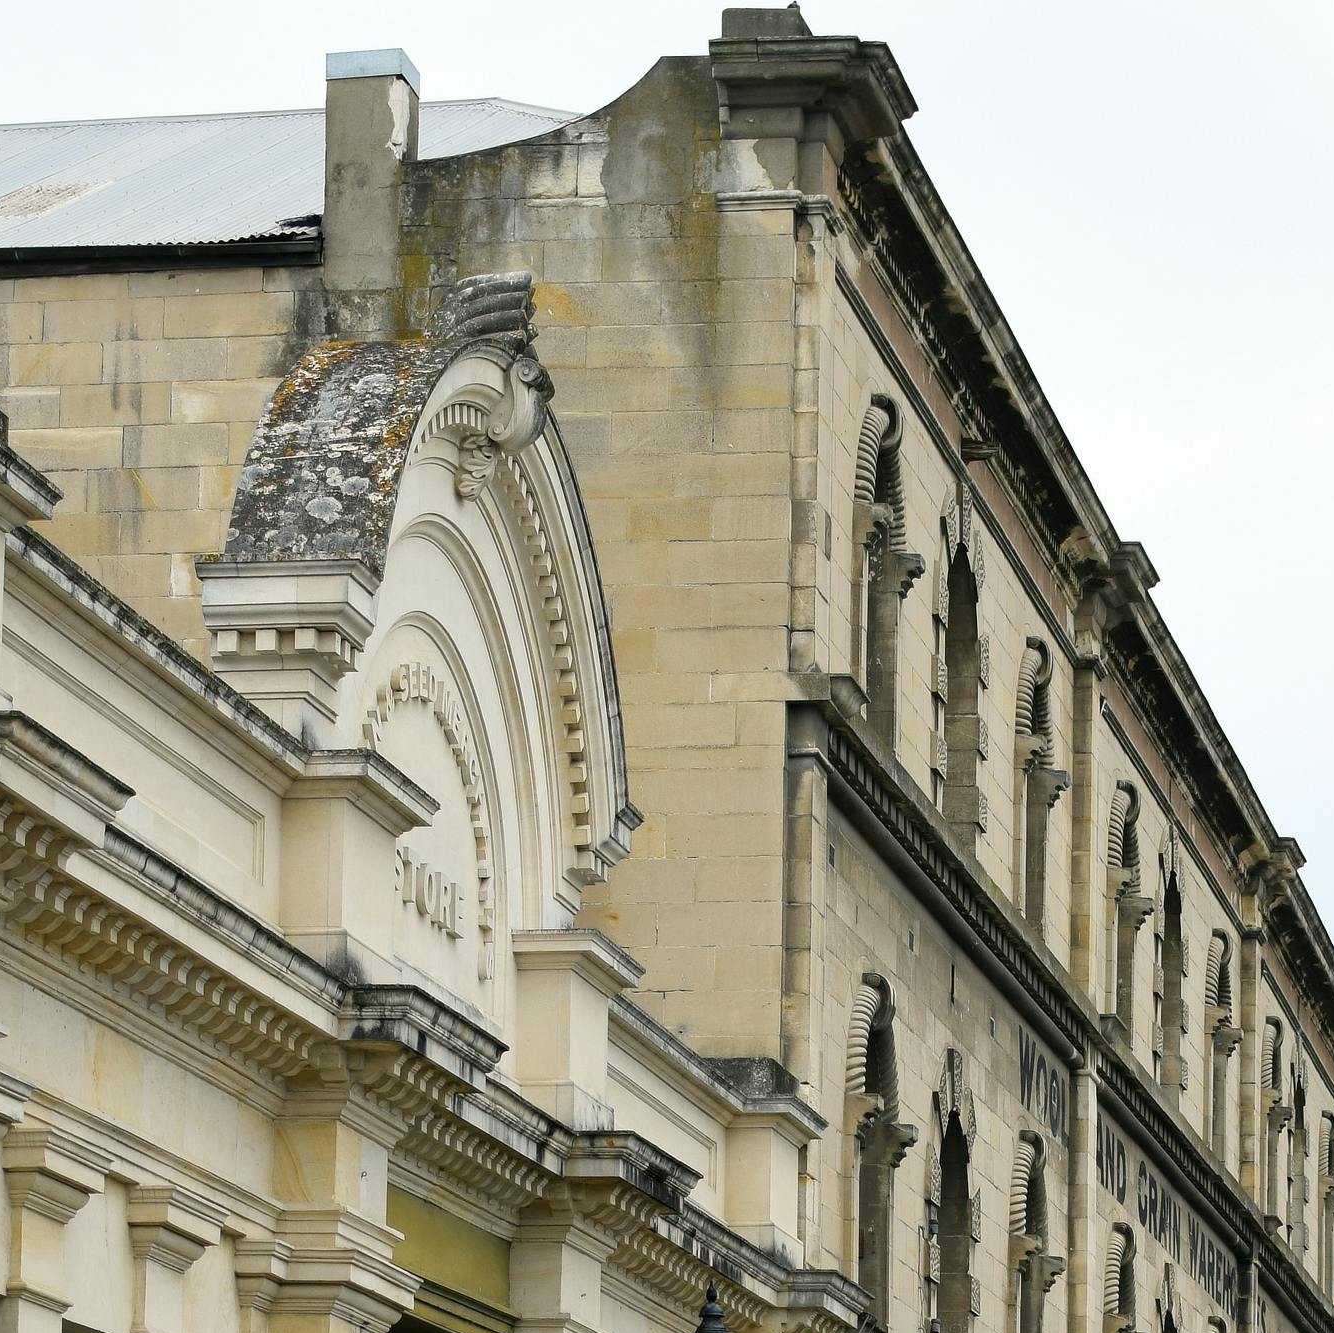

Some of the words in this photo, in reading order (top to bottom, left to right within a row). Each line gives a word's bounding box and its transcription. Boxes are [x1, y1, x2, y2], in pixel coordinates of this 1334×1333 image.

[391, 661, 437, 702] SEED
[394, 845, 466, 939] STORE
[1018, 1023, 1070, 1150] WOOL
[1096, 1110, 1127, 1206] AND
[1138, 1160, 1181, 1265] GRAIN
